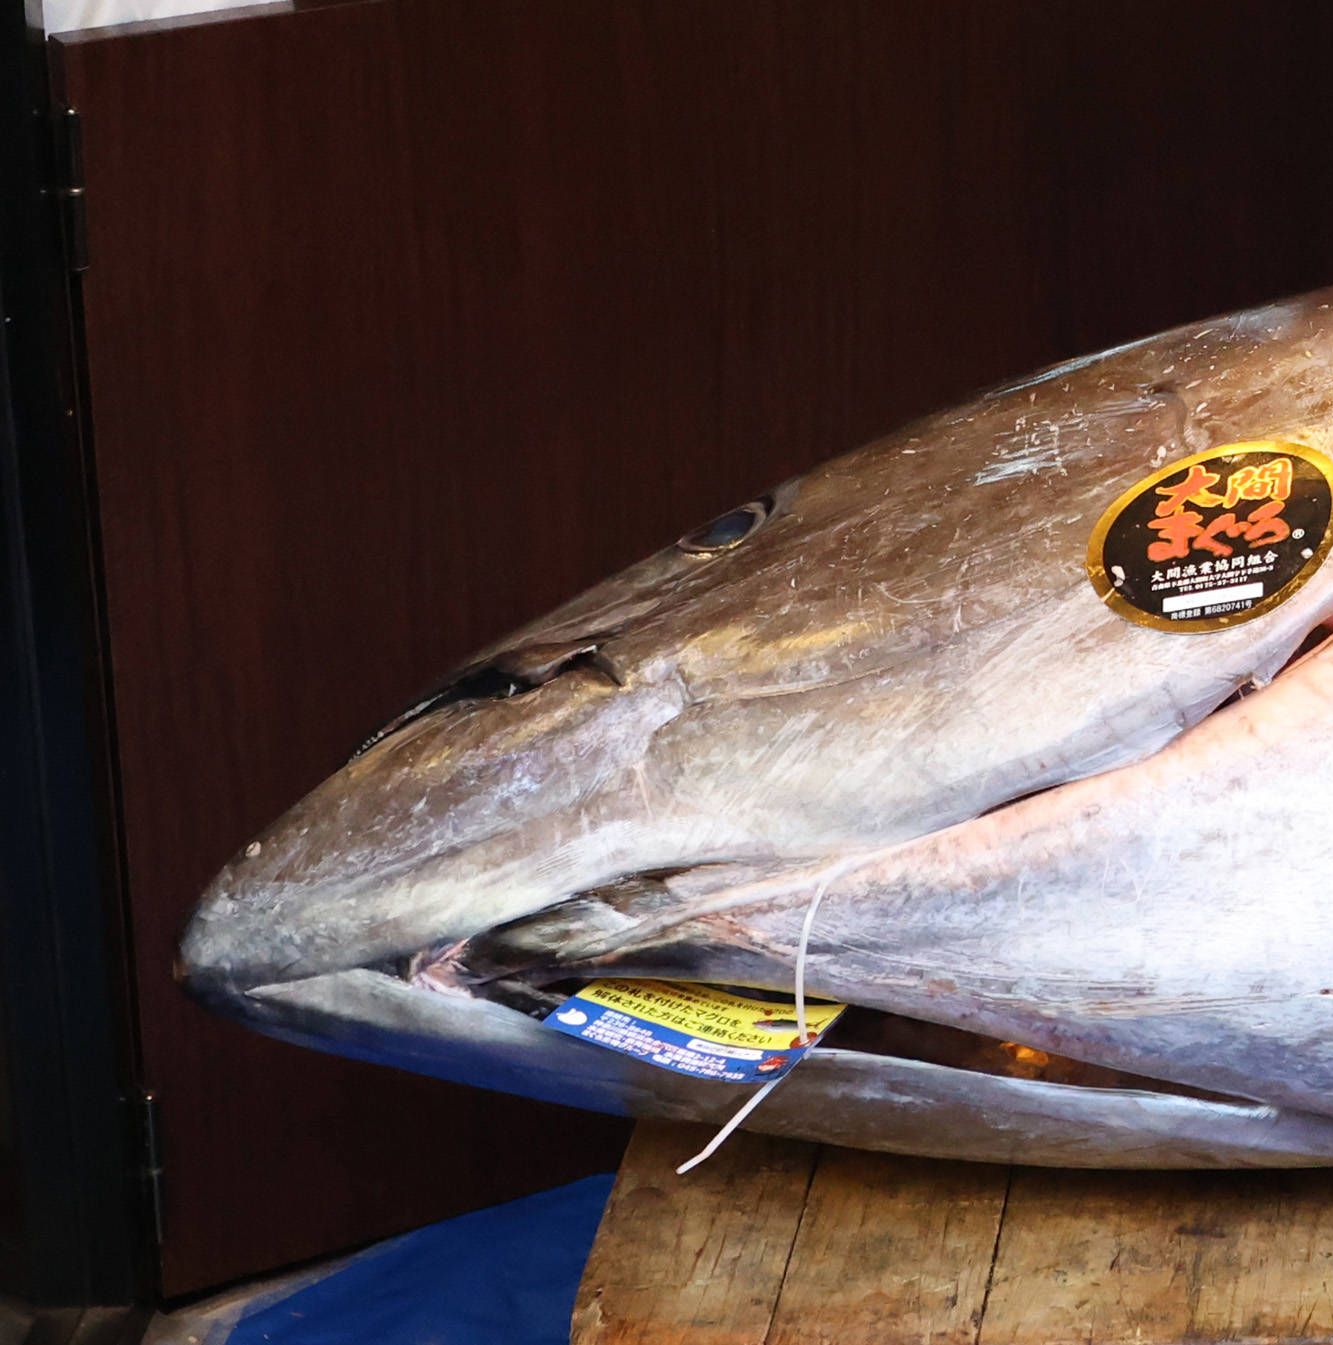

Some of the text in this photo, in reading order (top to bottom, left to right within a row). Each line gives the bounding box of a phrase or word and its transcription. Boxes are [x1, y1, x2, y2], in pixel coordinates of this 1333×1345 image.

[1155, 457, 1293, 517] 大間
[1147, 500, 1291, 562] まぐろ
